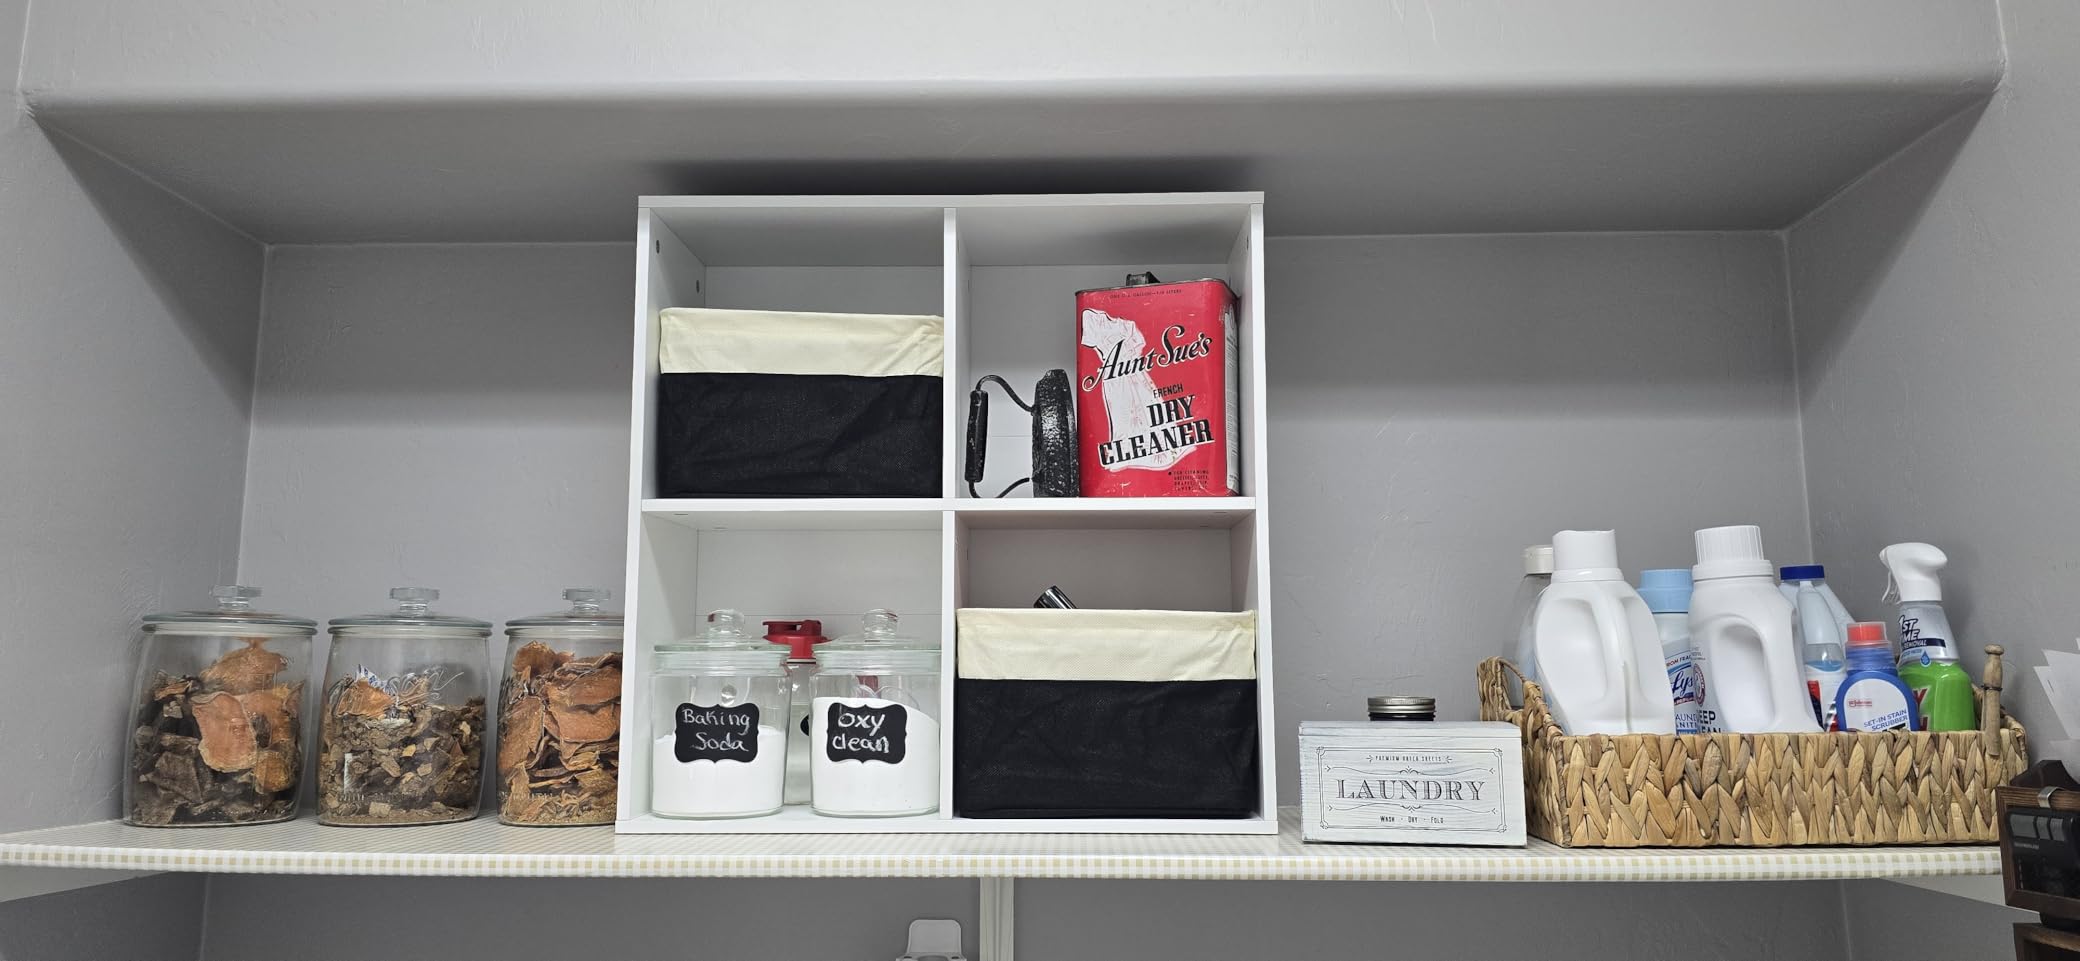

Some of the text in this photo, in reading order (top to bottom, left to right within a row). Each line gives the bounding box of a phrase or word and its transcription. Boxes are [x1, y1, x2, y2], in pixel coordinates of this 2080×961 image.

[1082, 339, 1157, 391] Aunt
[1157, 325, 1212, 367] Sue's
[1153, 383, 1184, 398] FRENCH
[1147, 394, 1196, 427] DRY
[1099, 418, 1215, 466] CLEANER
[1903, 630, 1921, 642] ME
[1671, 670, 1693, 696] Lys
[682, 708, 750, 736] Baking
[1697, 709, 1716, 724] EEP
[1864, 709, 1907, 728] SET-IN STAIN
[1871, 715, 1908, 731] SCRUBBER
[690, 731, 749, 752] Soda
[1336, 779, 1485, 801] LAUNDRY
